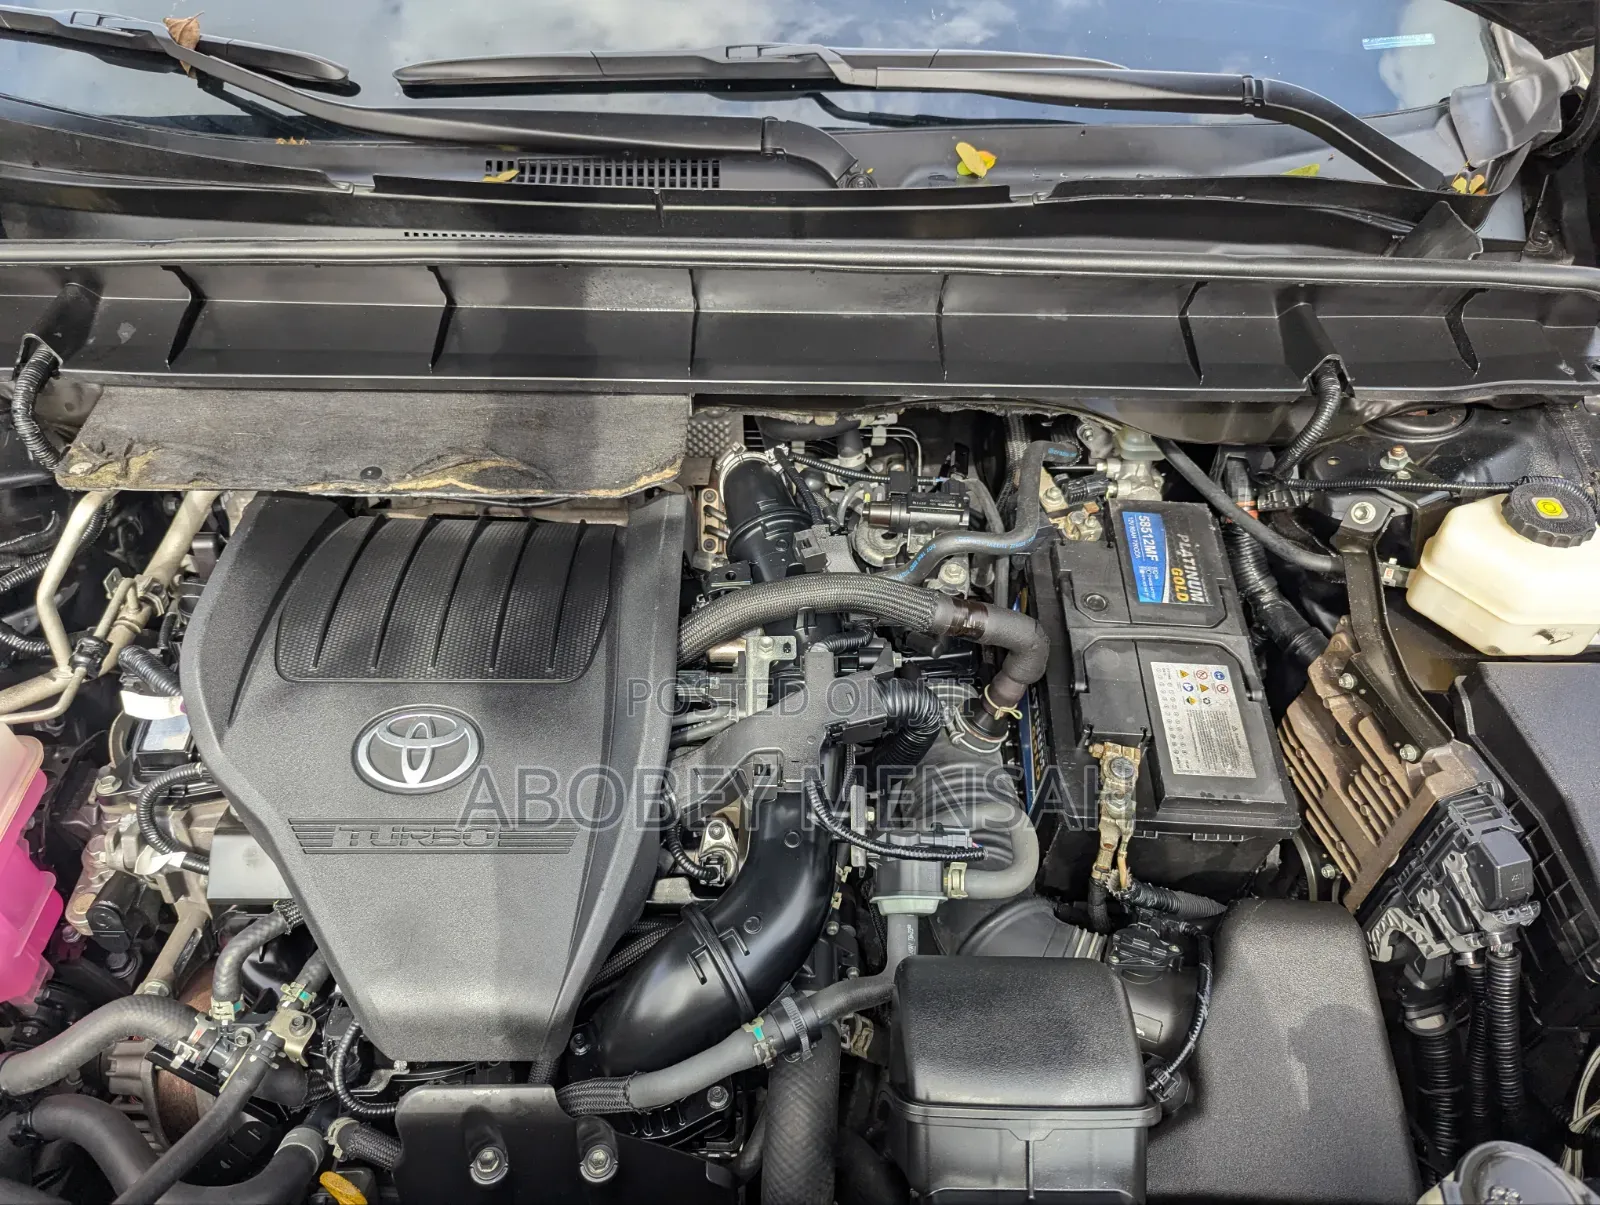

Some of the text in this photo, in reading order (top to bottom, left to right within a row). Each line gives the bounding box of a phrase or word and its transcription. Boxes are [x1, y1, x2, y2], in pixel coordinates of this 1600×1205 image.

[1138, 515, 1159, 561] 58512MF
[1170, 567, 1189, 602] GOLD
[1177, 533, 1205, 603] PLATINUM
[338, 825, 496, 848] TURBO
